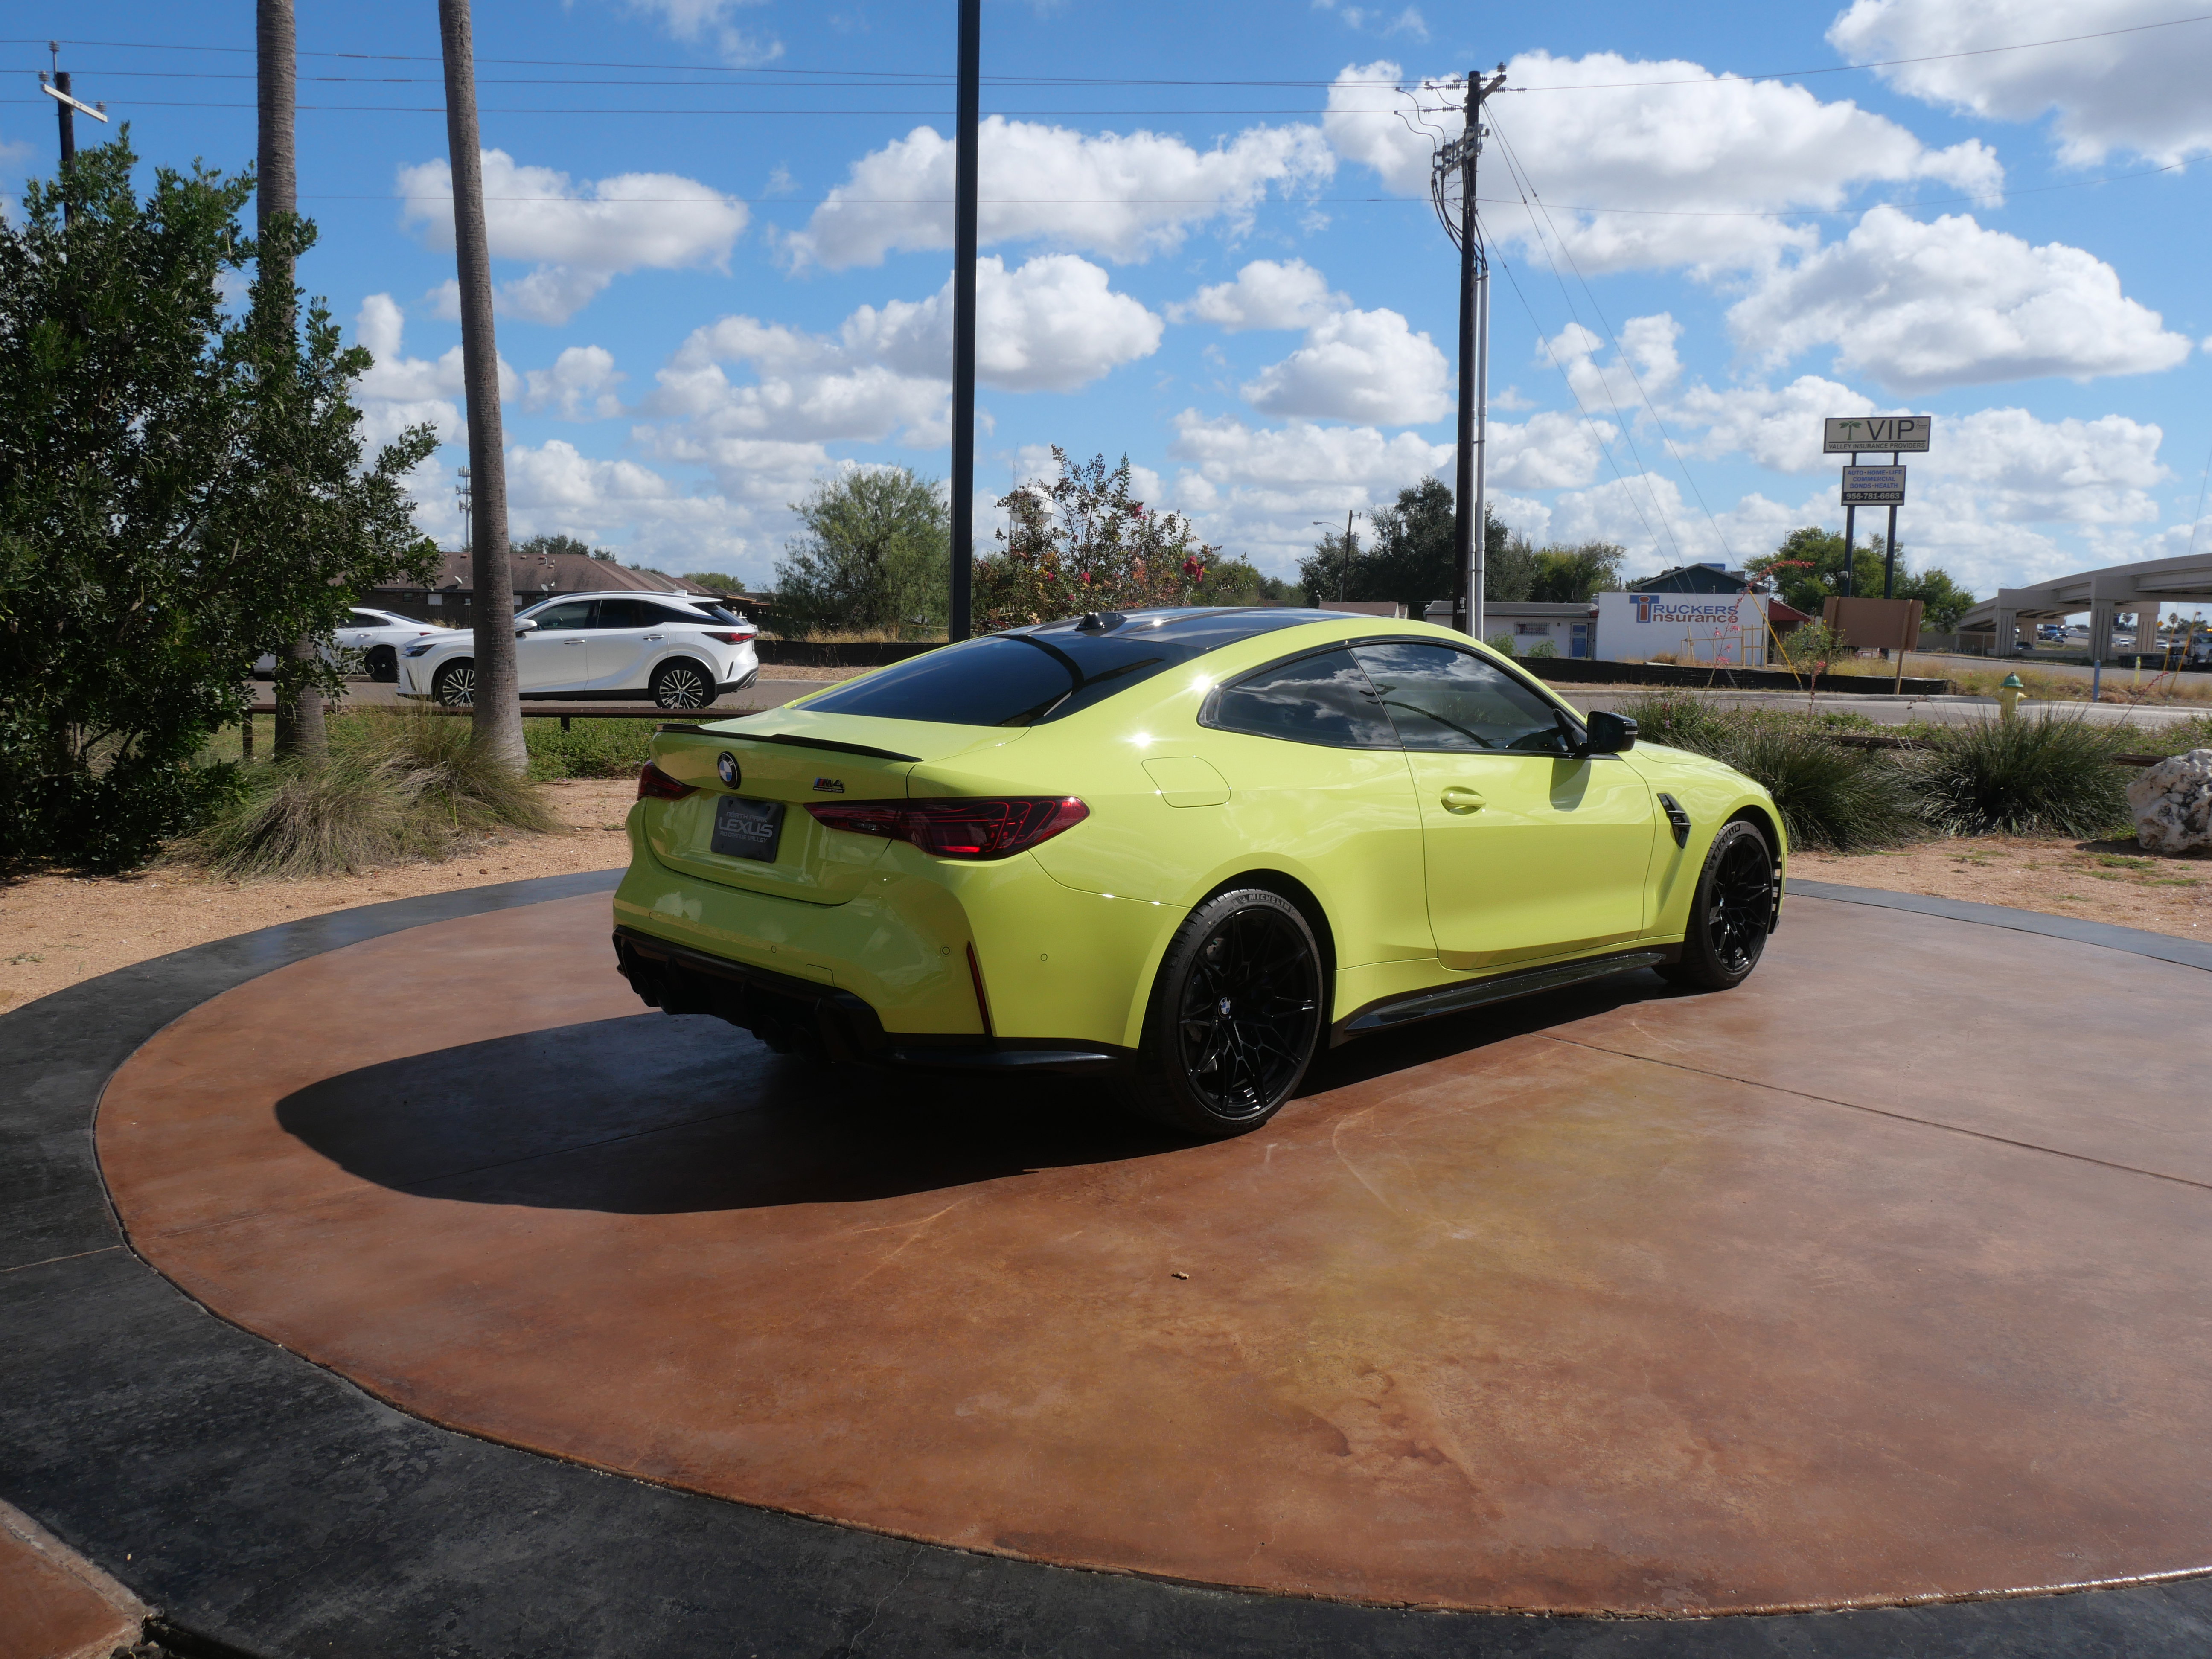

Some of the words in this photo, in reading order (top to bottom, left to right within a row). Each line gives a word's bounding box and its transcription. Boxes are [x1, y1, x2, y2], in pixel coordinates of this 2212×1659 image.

[1866, 419, 1915, 441] VIP
[726, 811, 748, 819] NORTH
[719, 817, 774, 838] LEXUS
[1249, 894, 1289, 910] MICHELIN
